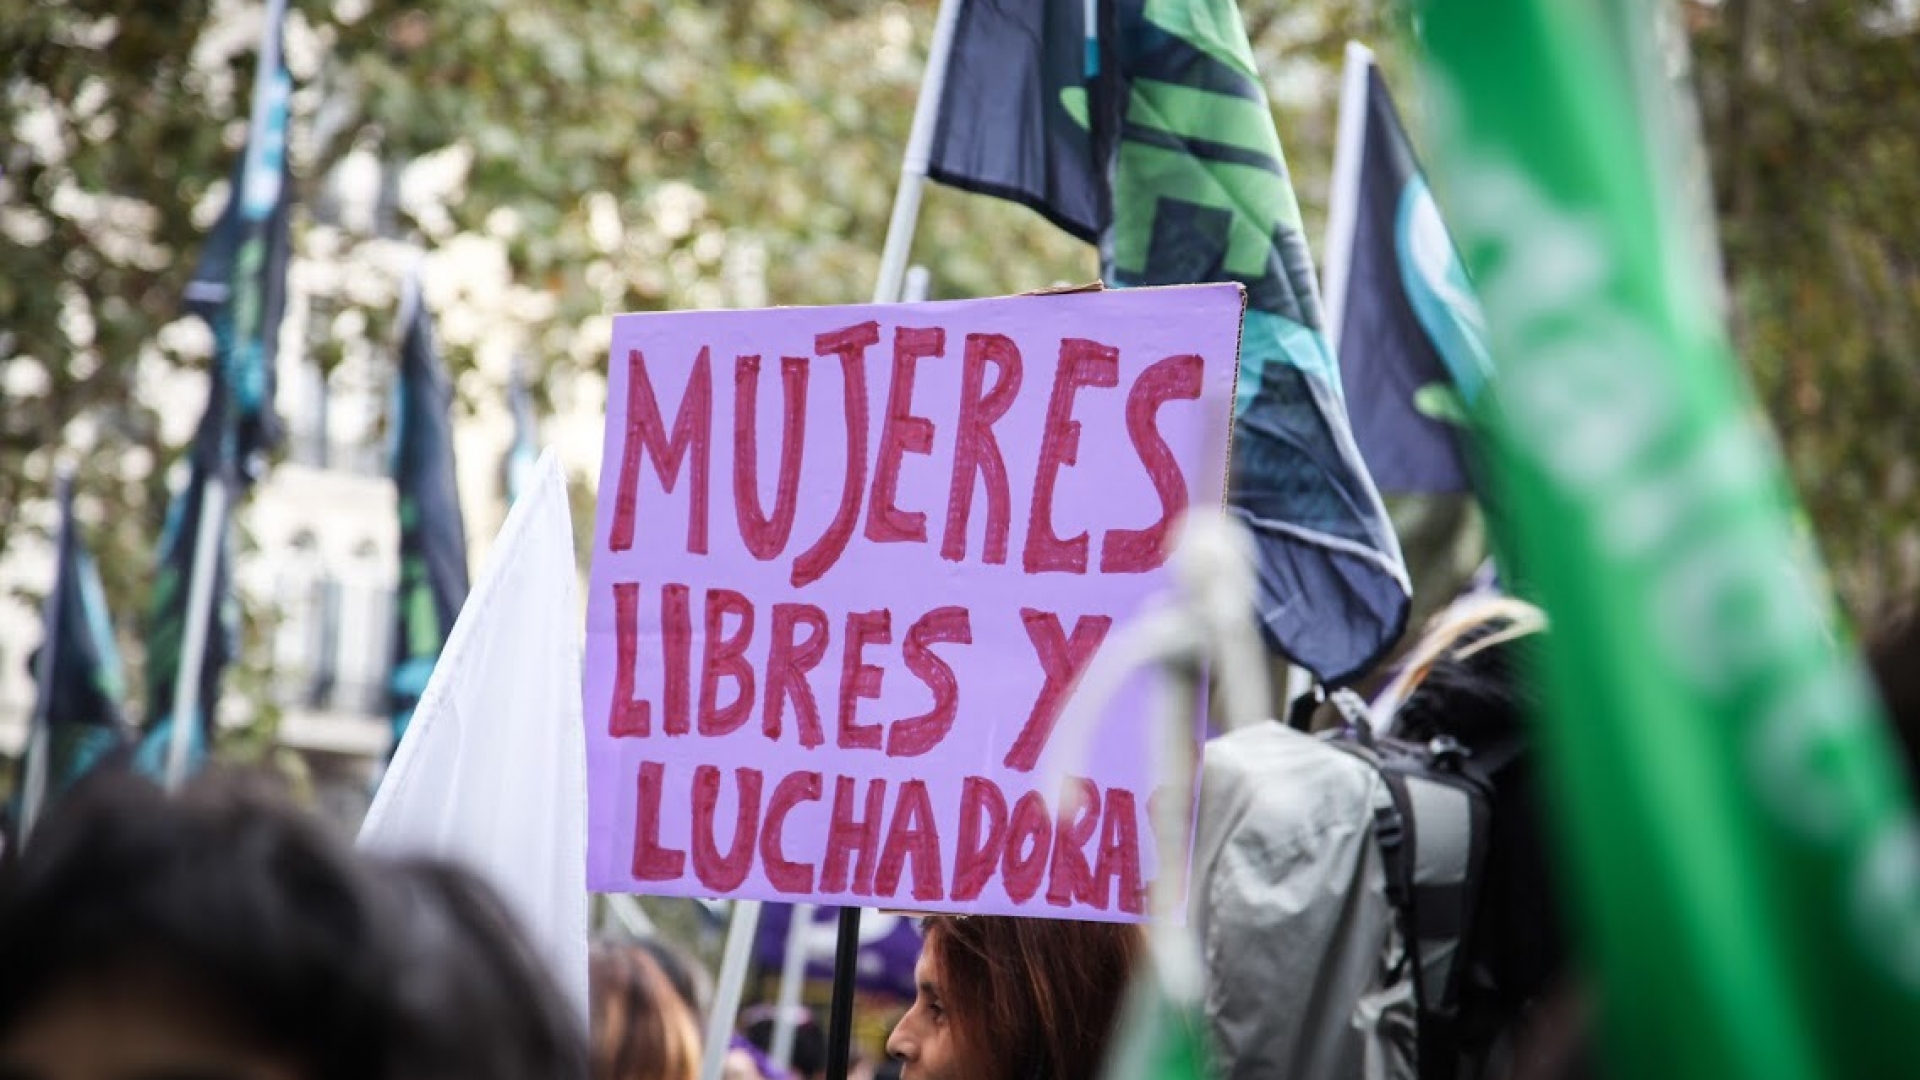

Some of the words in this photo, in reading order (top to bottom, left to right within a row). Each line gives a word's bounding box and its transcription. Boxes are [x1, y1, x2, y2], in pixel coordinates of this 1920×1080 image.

[609, 320, 1204, 588] MUJERES
[608, 582, 973, 758] LIBRES
[1003, 606, 1112, 771] Y
[631, 760, 1168, 916] LUCHADORA
